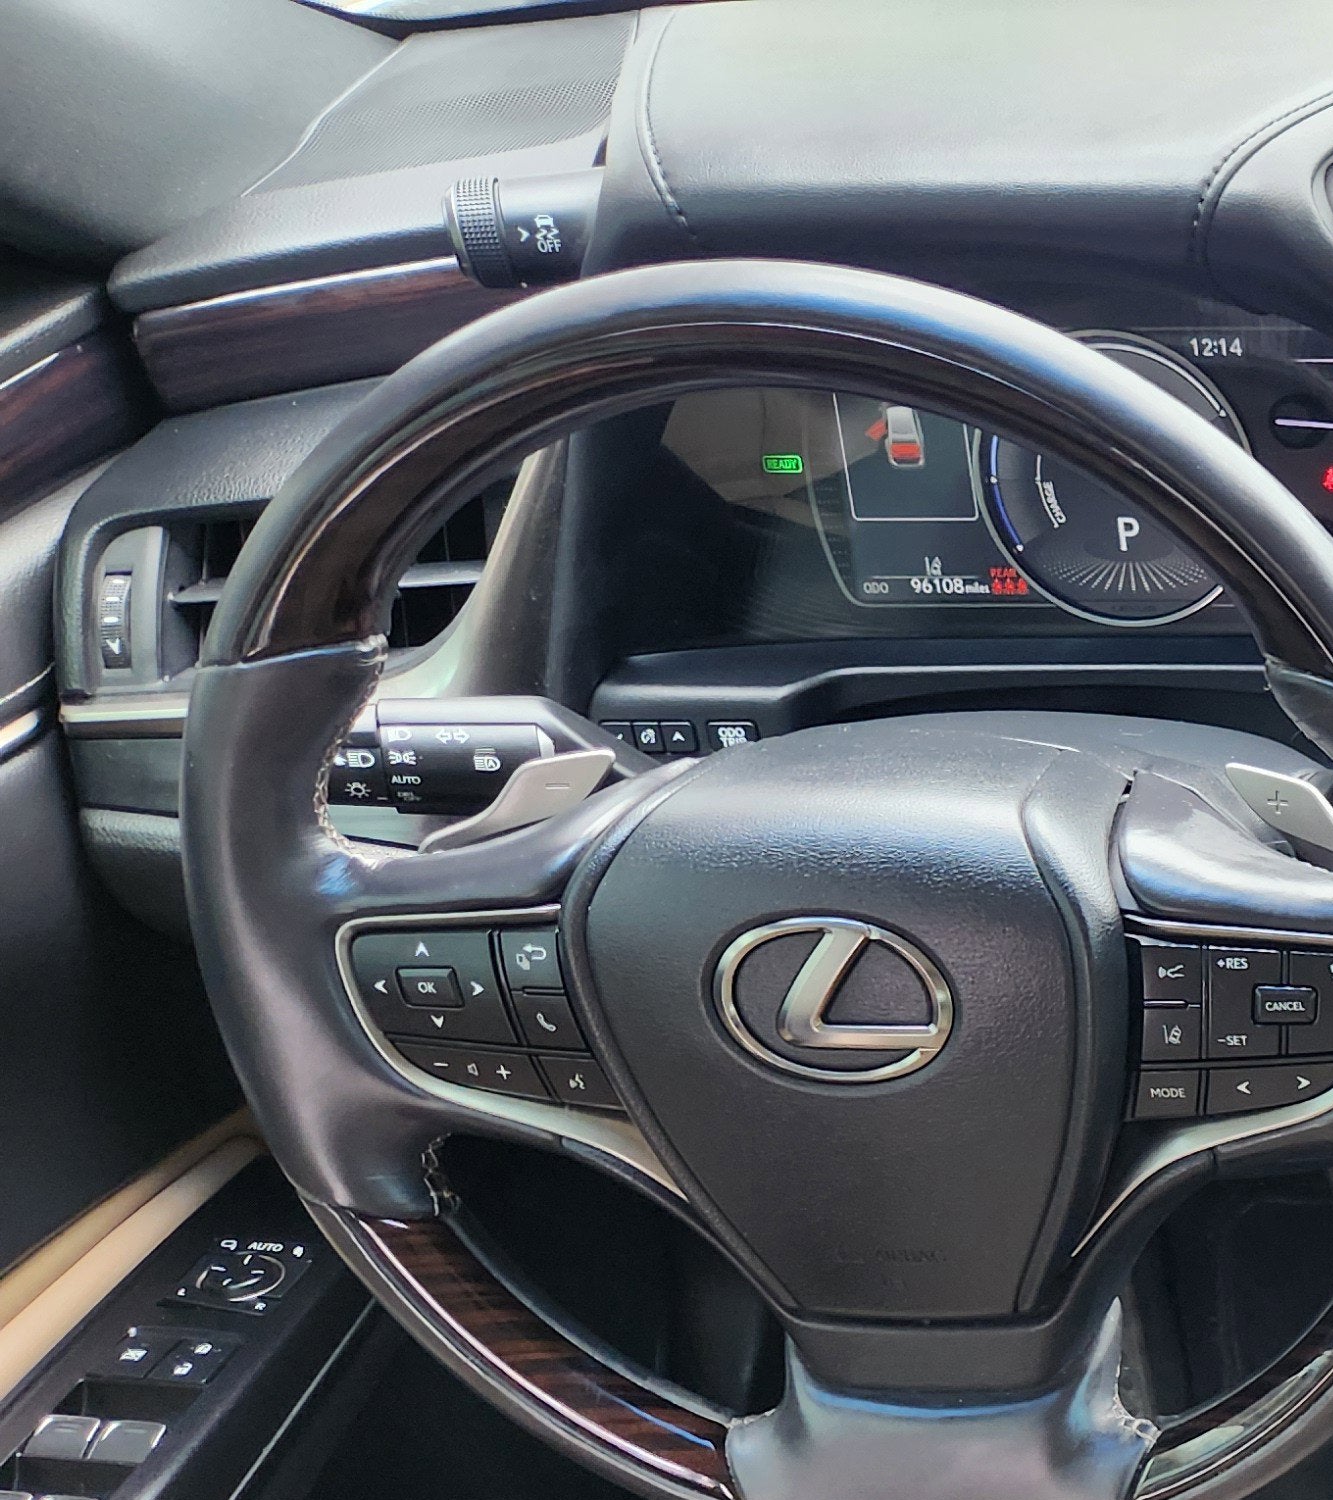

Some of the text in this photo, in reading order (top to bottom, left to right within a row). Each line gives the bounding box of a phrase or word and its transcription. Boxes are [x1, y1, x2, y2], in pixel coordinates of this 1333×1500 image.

[536, 238, 562, 253] OFF
[1189, 337, 1244, 358] 12:14
[765, 458, 799, 470] READY
[1116, 516, 1141, 552] P
[862, 581, 890, 595] ODO
[909, 578, 965, 595] 96108
[717, 726, 746, 738] ODO
[391, 775, 422, 785] AUTO
[417, 980, 438, 995] OK
[1264, 1000, 1306, 1012] CANCEL
[1149, 1087, 1187, 1099] MODE
[247, 1241, 284, 1252] AUTO
